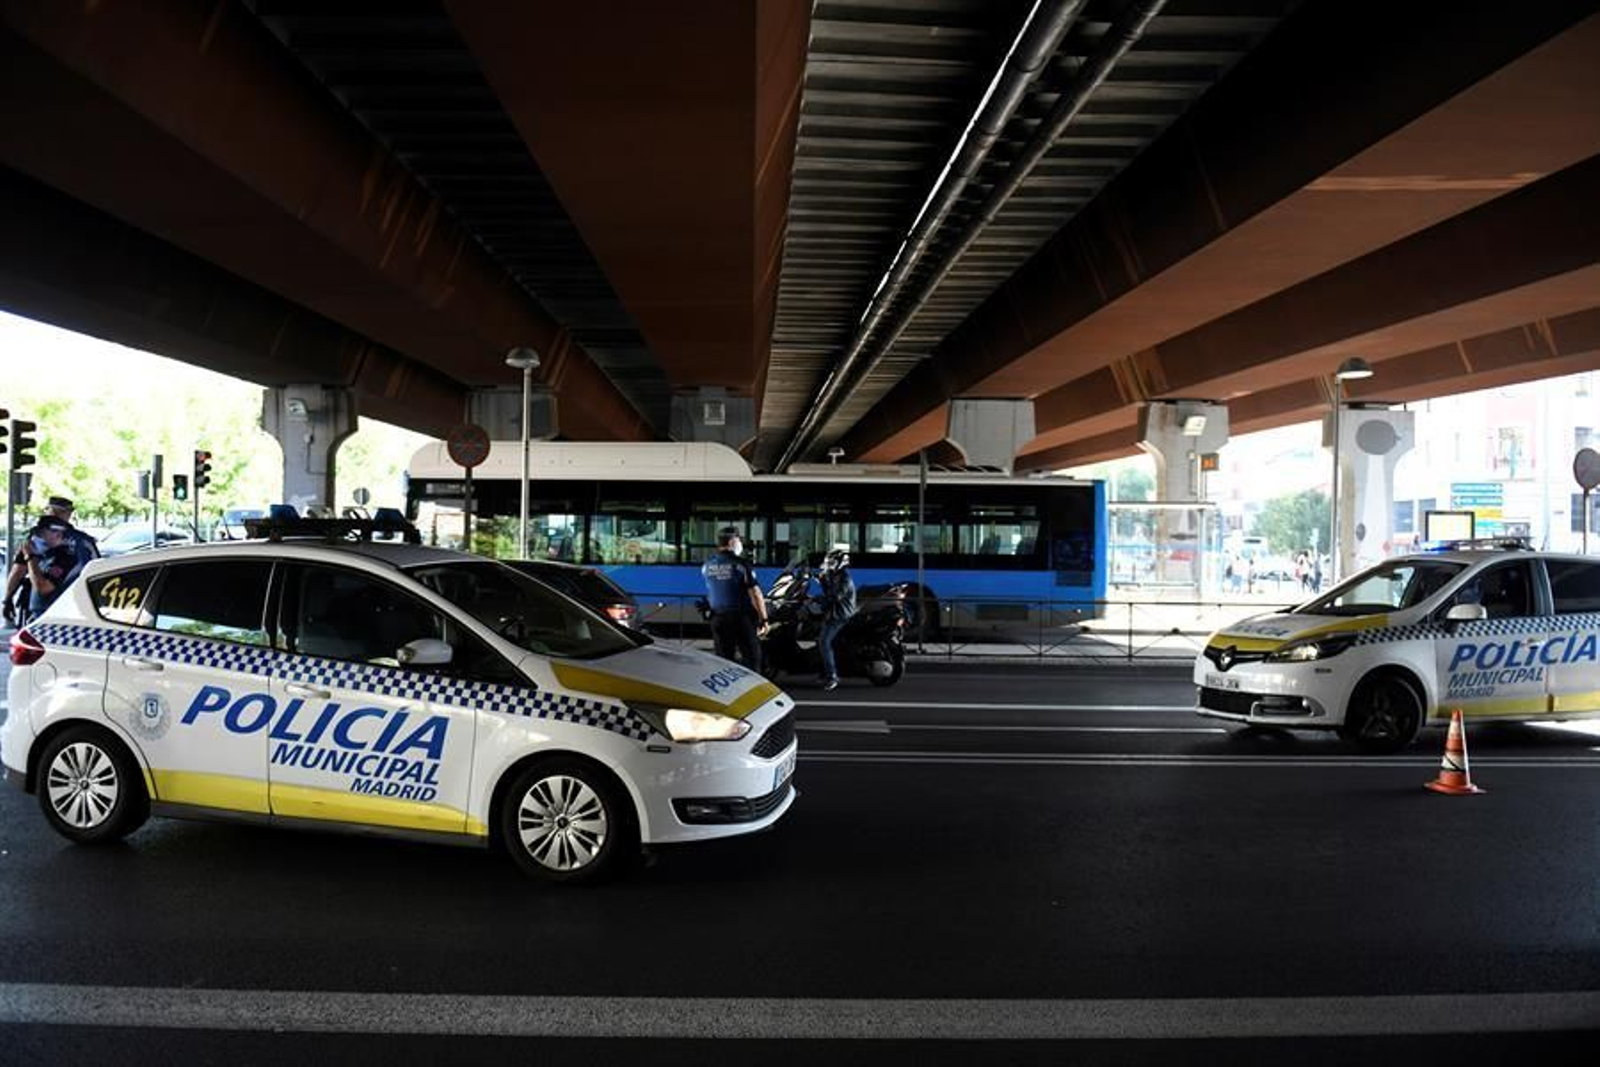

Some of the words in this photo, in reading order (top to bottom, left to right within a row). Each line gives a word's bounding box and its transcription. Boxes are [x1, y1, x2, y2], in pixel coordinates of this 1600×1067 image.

[108, 587, 141, 610] 112
[1448, 631, 1597, 672] POLICÍA
[1448, 667, 1544, 689] MUNICIPAL
[1447, 687, 1496, 699] MADRID
[181, 685, 450, 759] POLICÍA
[271, 743, 440, 785] MUNICIPAL
[350, 778, 437, 802] MADRID
